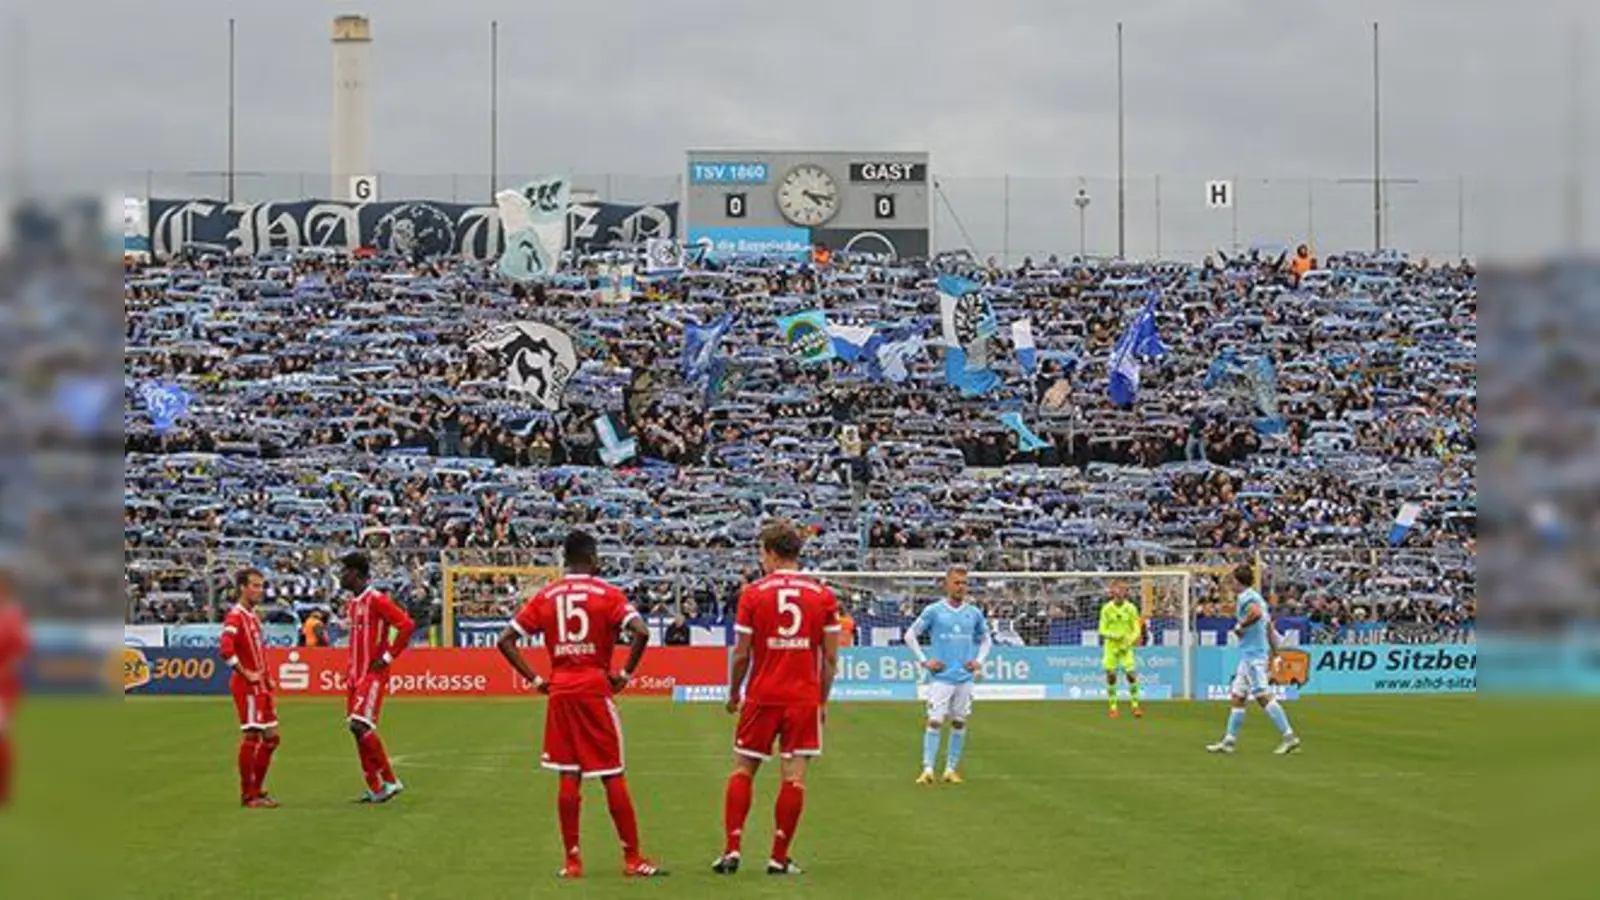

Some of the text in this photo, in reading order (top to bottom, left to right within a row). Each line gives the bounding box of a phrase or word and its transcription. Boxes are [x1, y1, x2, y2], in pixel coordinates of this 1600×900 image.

[694, 165, 765, 180] TSV 1860
[861, 163, 914, 180] GAST
[355, 179, 371, 199] G
[1211, 184, 1227, 204] H
[730, 197, 741, 215] 0
[878, 198, 890, 216] 0
[556, 592, 589, 642] 15
[777, 588, 802, 637] 5
[153, 657, 215, 679] 3000
[879, 654, 1029, 684] Bayche
[1316, 651, 1377, 671] AHD
[320, 669, 486, 695] Stparkasse
